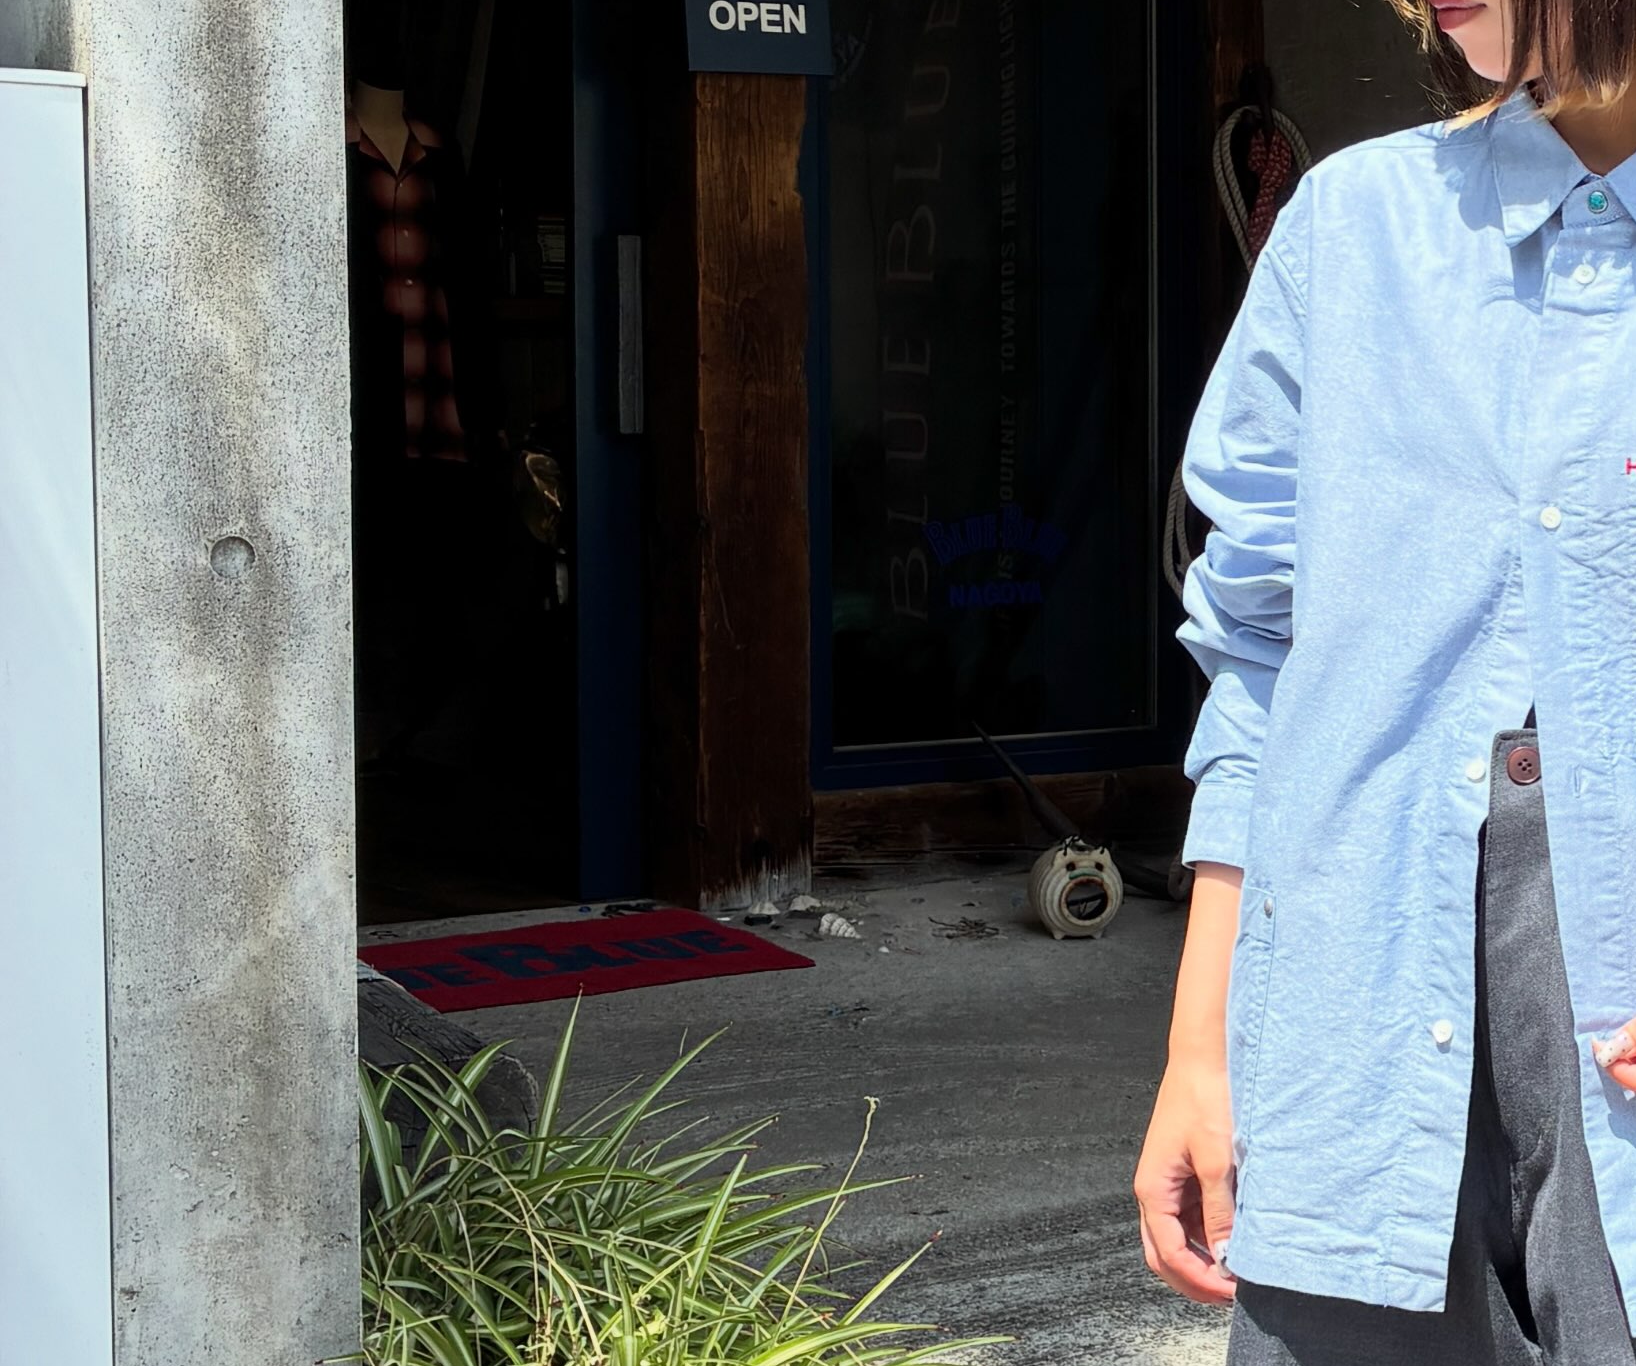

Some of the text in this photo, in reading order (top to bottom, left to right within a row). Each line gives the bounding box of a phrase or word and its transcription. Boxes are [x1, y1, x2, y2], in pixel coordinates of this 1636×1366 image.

[708, 0, 807, 34] OPEN
[1000, 395, 1017, 509] OURNEY
[880, 336, 932, 623] BLUE
[949, 579, 1043, 609] NAGOYA
[457, 930, 749, 979] BLUE
